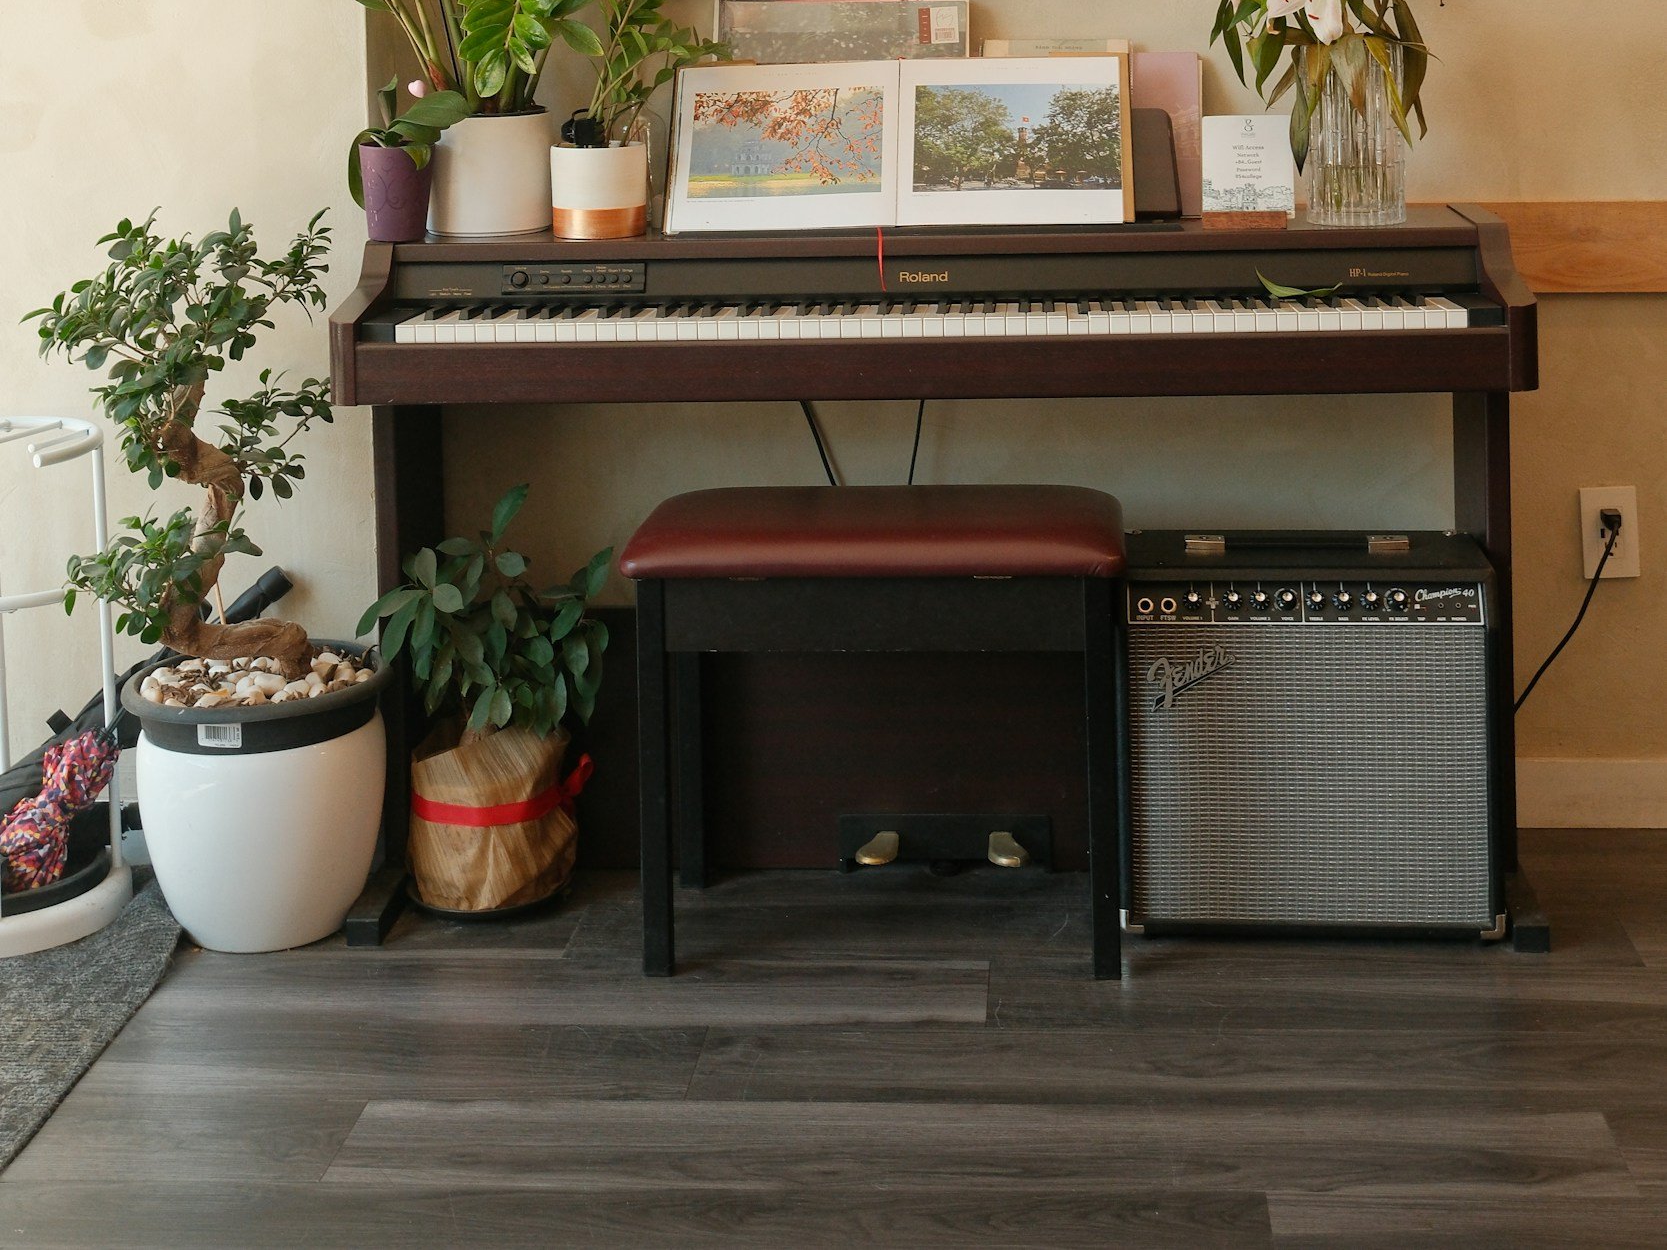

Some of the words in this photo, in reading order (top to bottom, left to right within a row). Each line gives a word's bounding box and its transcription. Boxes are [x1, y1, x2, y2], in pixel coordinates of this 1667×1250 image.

[899, 271, 949, 283] Roland
[1414, 587, 1462, 602] Champion
[1462, 587, 1475, 597] 40
[1146, 645, 1229, 708] Fender
